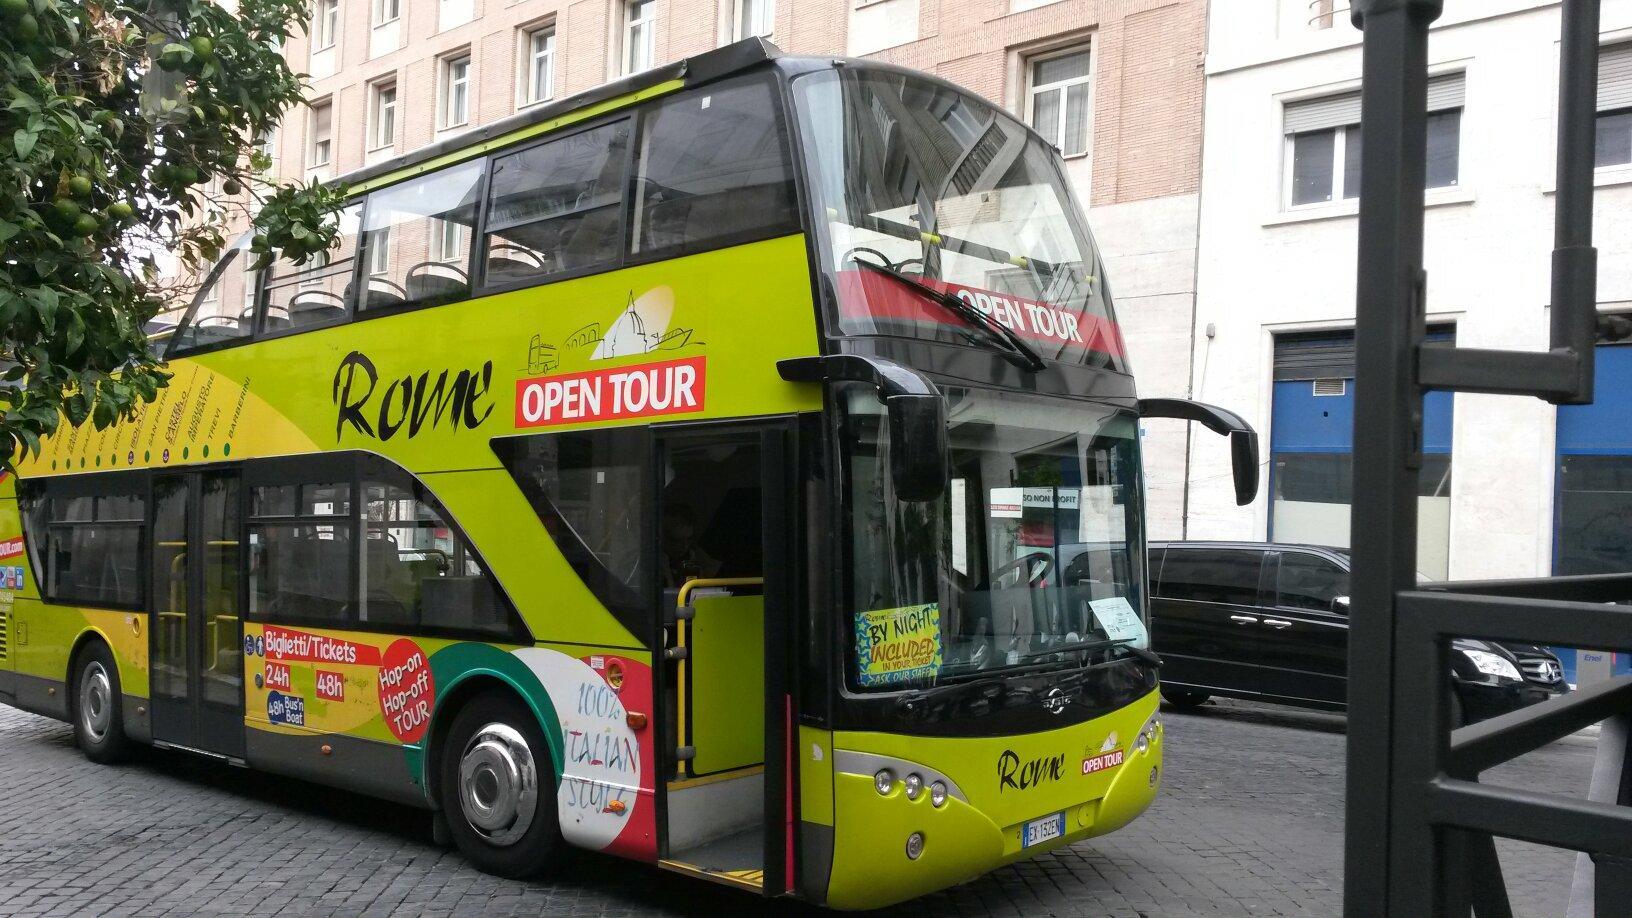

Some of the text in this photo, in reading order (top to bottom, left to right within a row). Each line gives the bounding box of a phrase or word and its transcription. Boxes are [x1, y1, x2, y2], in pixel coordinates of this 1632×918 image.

[958, 290, 1083, 343] OPEN TOUR
[228, 376, 251, 439] BARBERINI
[333, 351, 495, 444] Rome
[522, 364, 697, 422] OPEN TOUR
[207, 407, 222, 440] TREVI
[1034, 494, 1050, 503] NON
[869, 607, 931, 645] BY NIGHT
[265, 630, 357, 663] Biglietti/Tickets
[870, 638, 934, 663] INCLUDED
[266, 664, 290, 688] 24h
[316, 673, 344, 697] 48h
[379, 652, 423, 691] Hop-on
[874, 673, 891, 685] ASK
[893, 670, 911, 681] OUR
[882, 662, 891, 671] IN
[892, 659, 911, 669] YOUR
[268, 700, 285, 716] 48h
[382, 669, 429, 717] Hop-off
[578, 682, 621, 719] 100%
[285, 711, 304, 725] Boat
[393, 699, 431, 735] TOUR
[563, 729, 640, 773] ITALIAN
[1083, 751, 1123, 774] OPEN TOUR
[997, 749, 1066, 794] Rome
